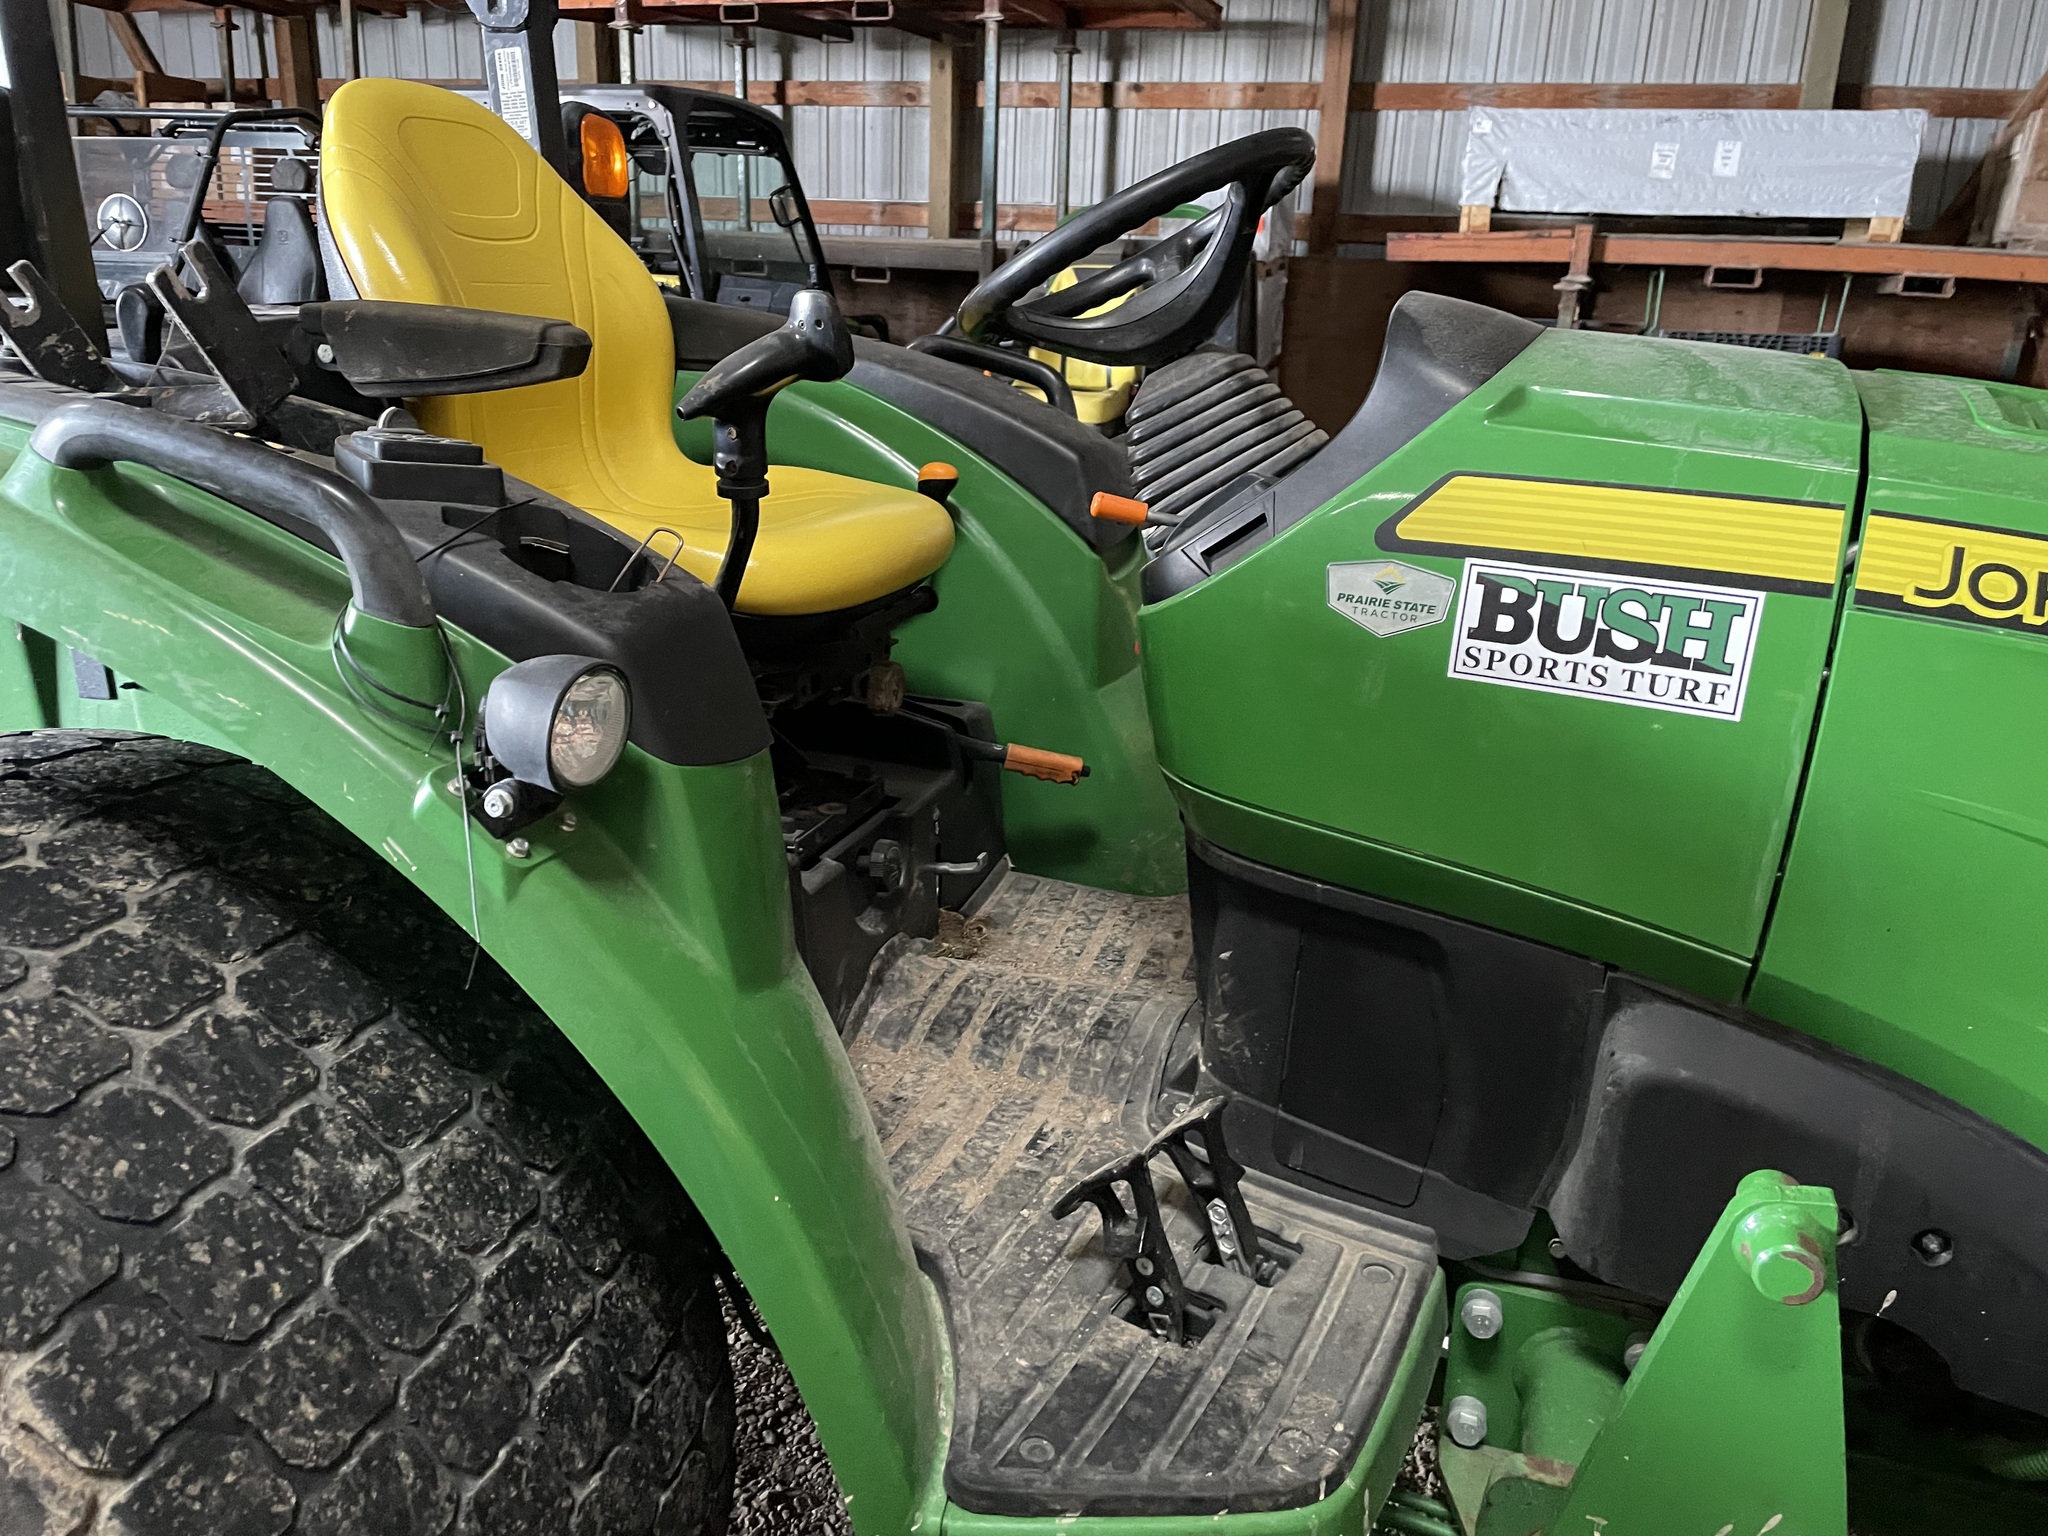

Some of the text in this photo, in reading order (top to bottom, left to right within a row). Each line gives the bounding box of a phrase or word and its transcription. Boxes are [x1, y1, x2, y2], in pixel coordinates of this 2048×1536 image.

[1337, 593, 1437, 614] PRAIRIE STATE
[1352, 606, 1418, 622] TRACTOR
[1467, 572, 1746, 676] BUSH
[1462, 646, 1731, 706] SPORTS TURF
